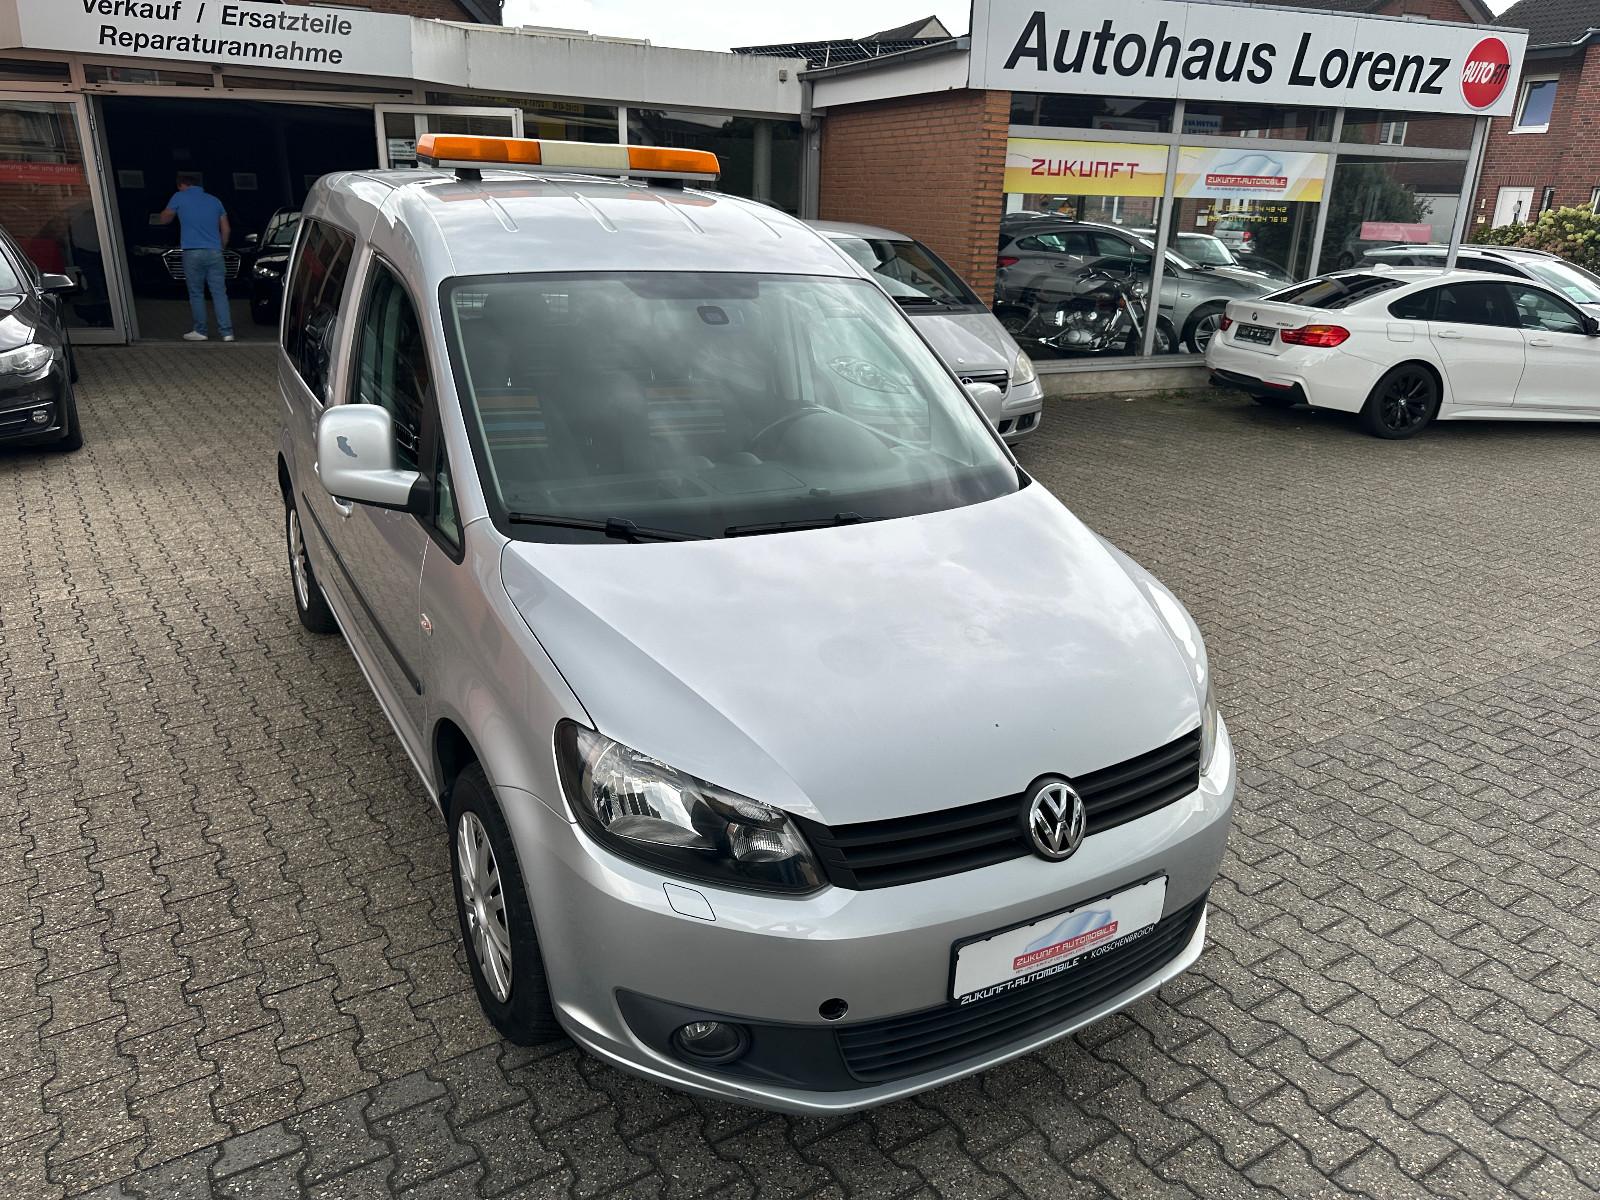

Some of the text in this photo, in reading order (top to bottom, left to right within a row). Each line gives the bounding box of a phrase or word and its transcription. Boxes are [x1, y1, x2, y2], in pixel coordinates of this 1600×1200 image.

[83, 0, 182, 21] Verkauf
[221, 5, 352, 36] Ersatzteile
[99, 25, 343, 64] Reparaturannahme
[1003, 11, 1452, 95] Autohaus Lorenz
[1031, 158, 1140, 179] ZUKUNFT
[1090, 924, 1155, 959] KORSCHENBROICH
